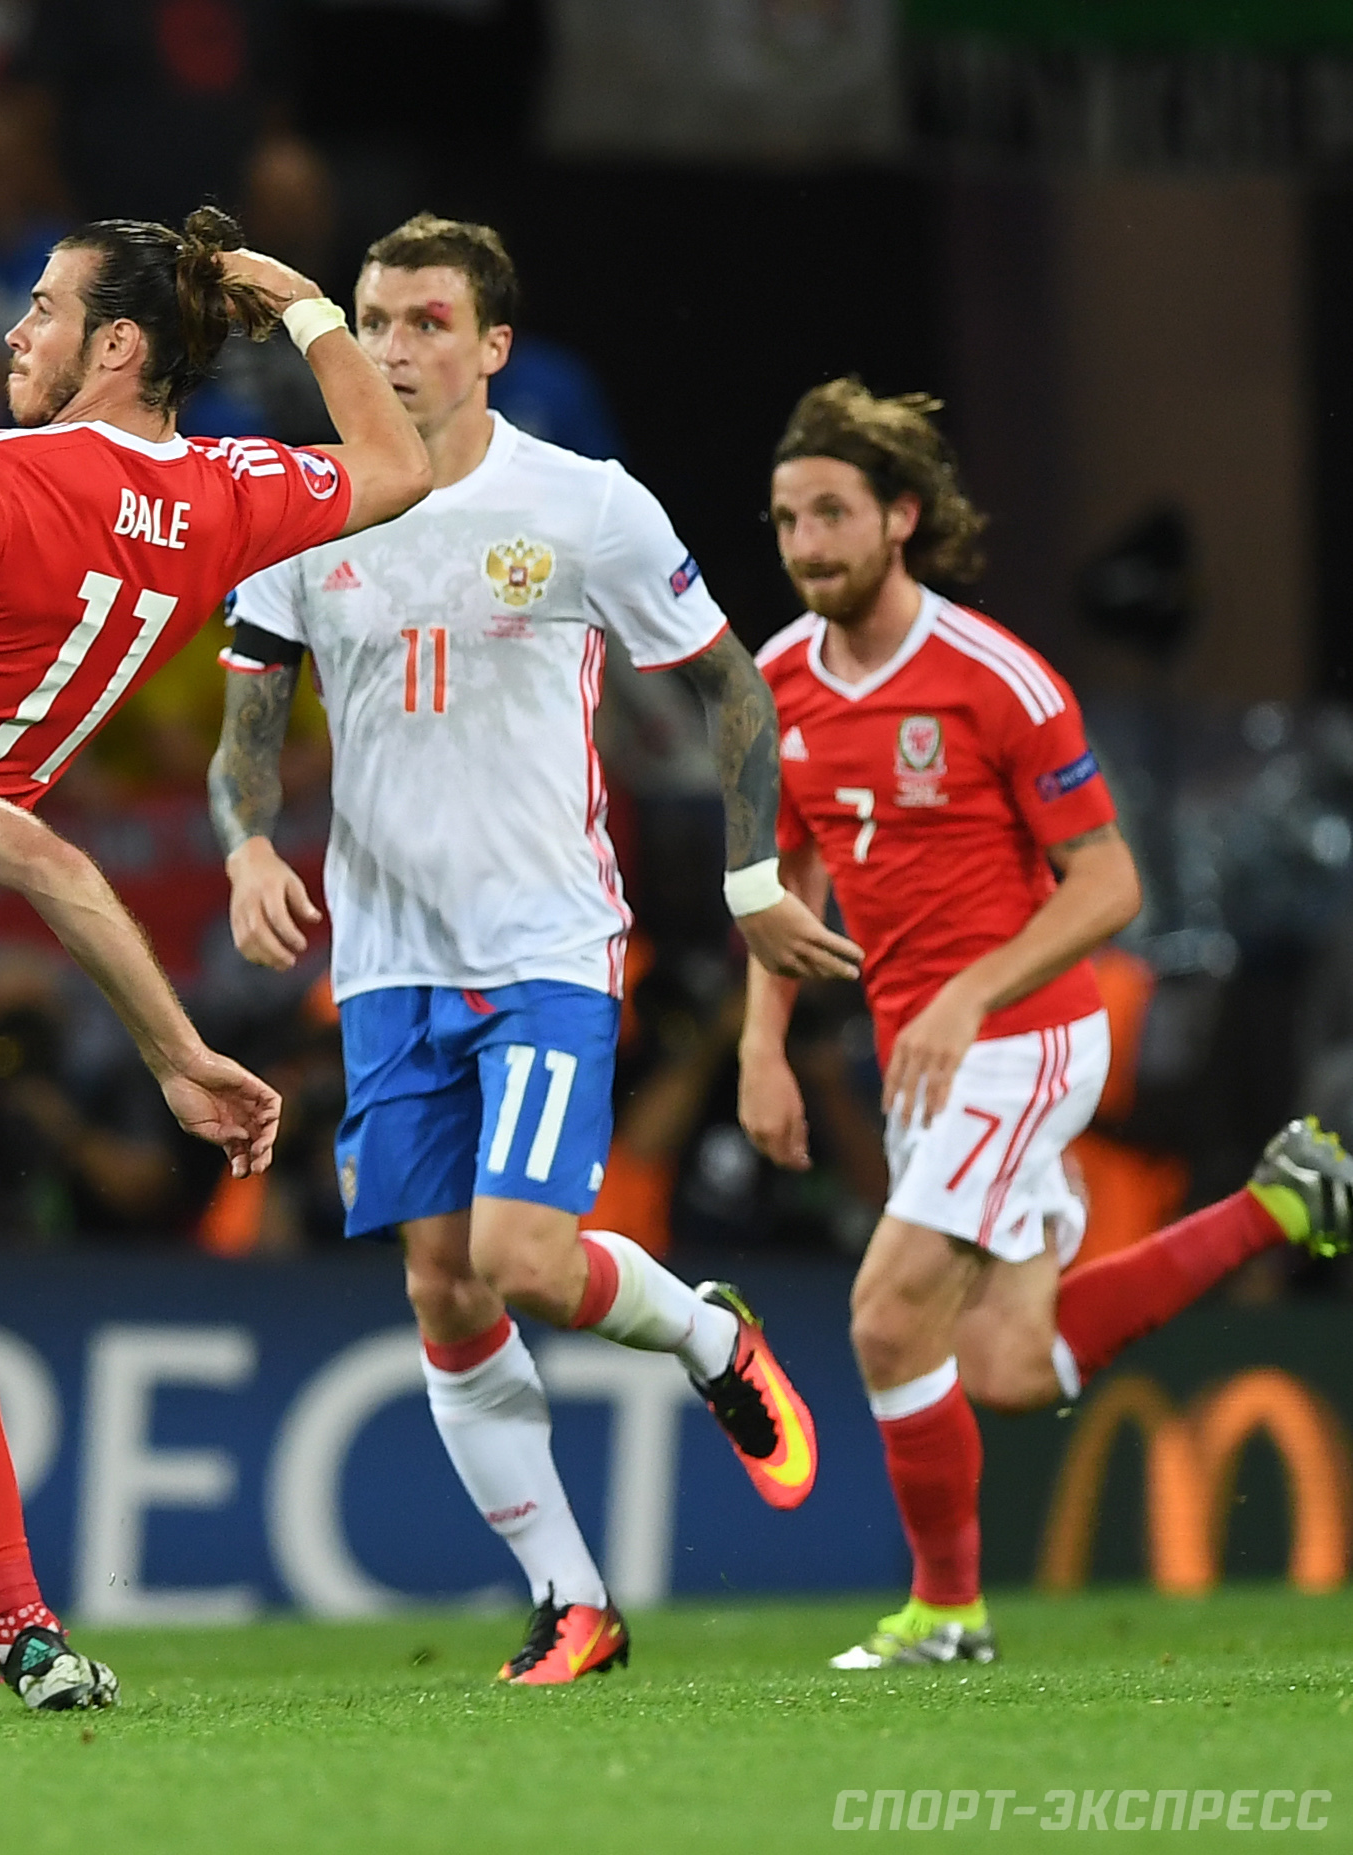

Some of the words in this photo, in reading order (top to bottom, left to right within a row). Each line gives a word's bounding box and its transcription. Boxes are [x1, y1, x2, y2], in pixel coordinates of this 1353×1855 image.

[114, 487, 191, 549] BALE
[400, 627, 446, 713] 11
[834, 786, 877, 865] 7
[487, 1043, 579, 1184] 11
[945, 1106, 1003, 1191] 7
